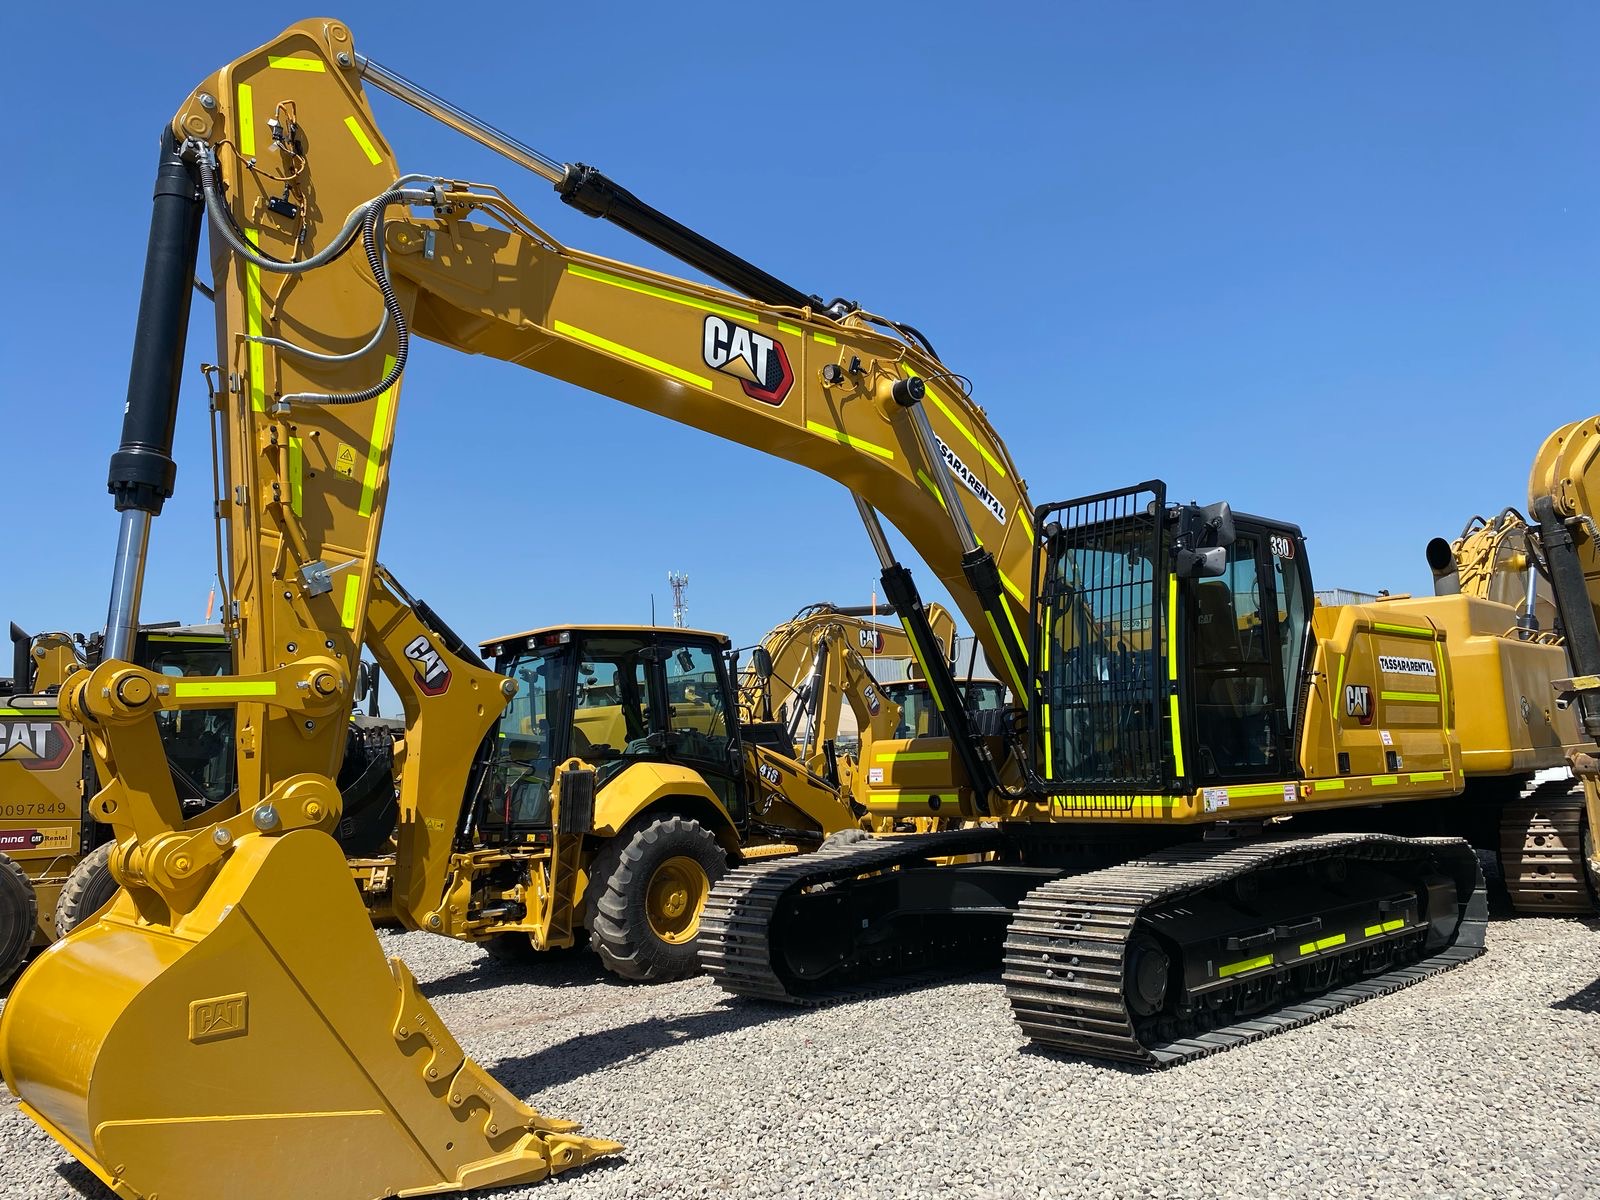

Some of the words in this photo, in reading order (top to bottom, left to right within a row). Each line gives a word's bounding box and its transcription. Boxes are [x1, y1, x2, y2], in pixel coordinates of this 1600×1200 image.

[704, 316, 773, 386] CAT
[1270, 536, 1289, 557] 330
[860, 630, 879, 648] CAT
[405, 636, 449, 683] CAT
[864, 685, 880, 710] CAT
[1346, 686, 1368, 716] CAT
[196, 1000, 243, 1035] CAT
